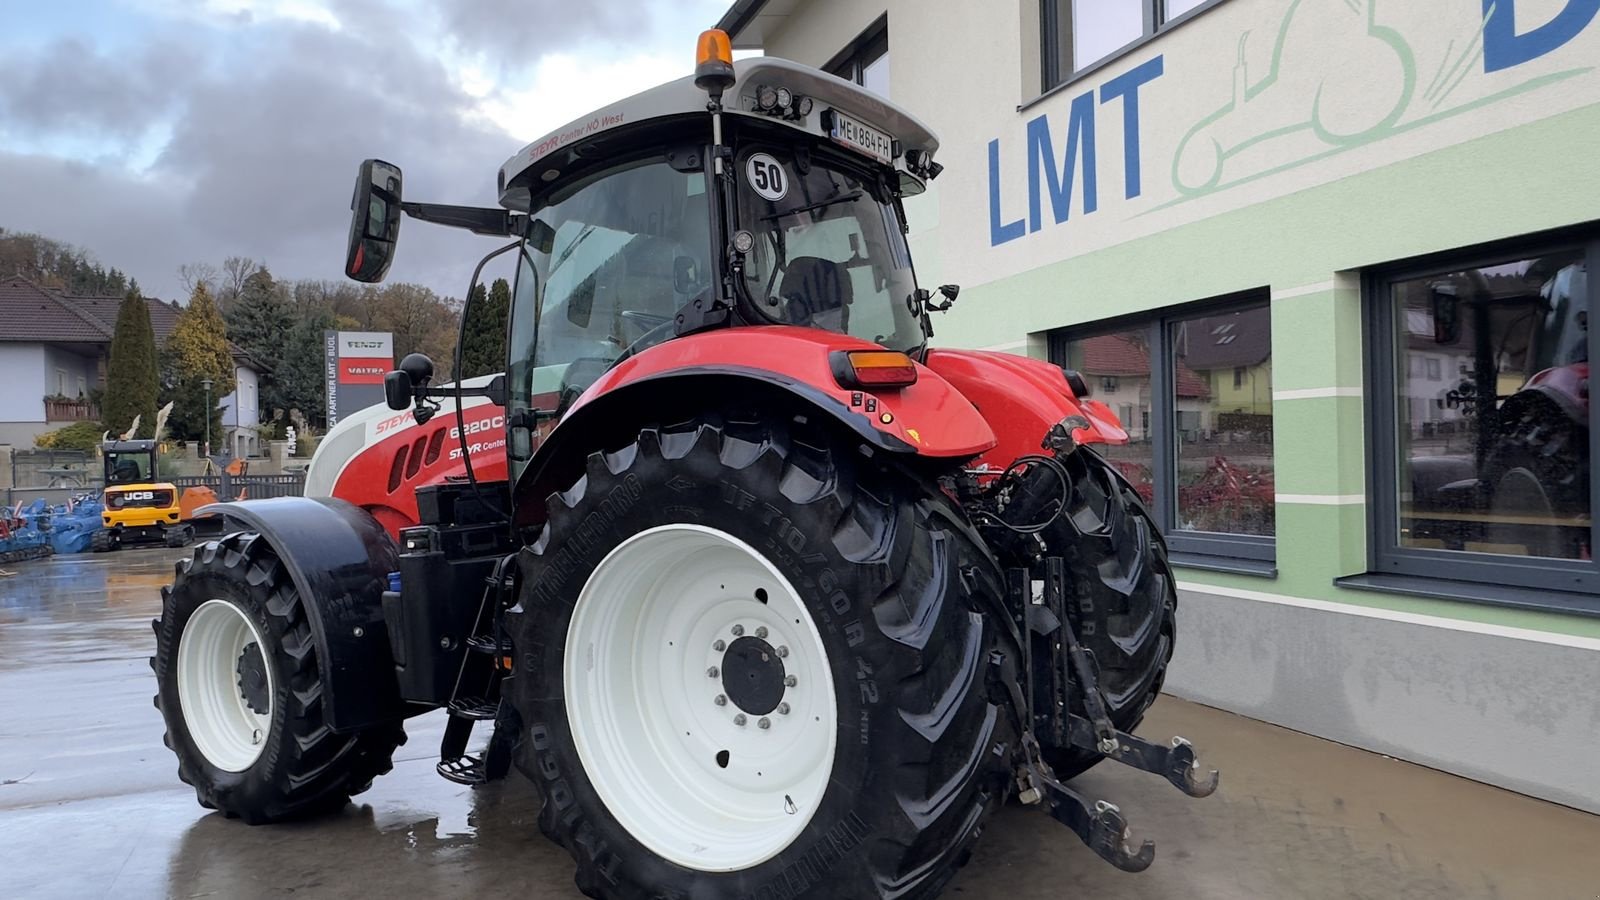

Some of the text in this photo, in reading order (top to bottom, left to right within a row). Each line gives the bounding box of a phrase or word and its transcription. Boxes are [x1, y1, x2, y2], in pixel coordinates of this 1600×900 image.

[529, 136, 559, 161] STEYR
[560, 127, 585, 143] Center
[601, 113, 624, 127] West
[840, 118, 852, 140] ME
[988, 54, 1164, 247] LMT
[754, 161, 783, 193] 50
[347, 341, 384, 349] FENDT
[328, 361, 336, 379] LMT
[348, 367, 384, 375] VALTRA
[328, 379, 337, 415] PARTNER
[124, 491, 154, 501] JCB
